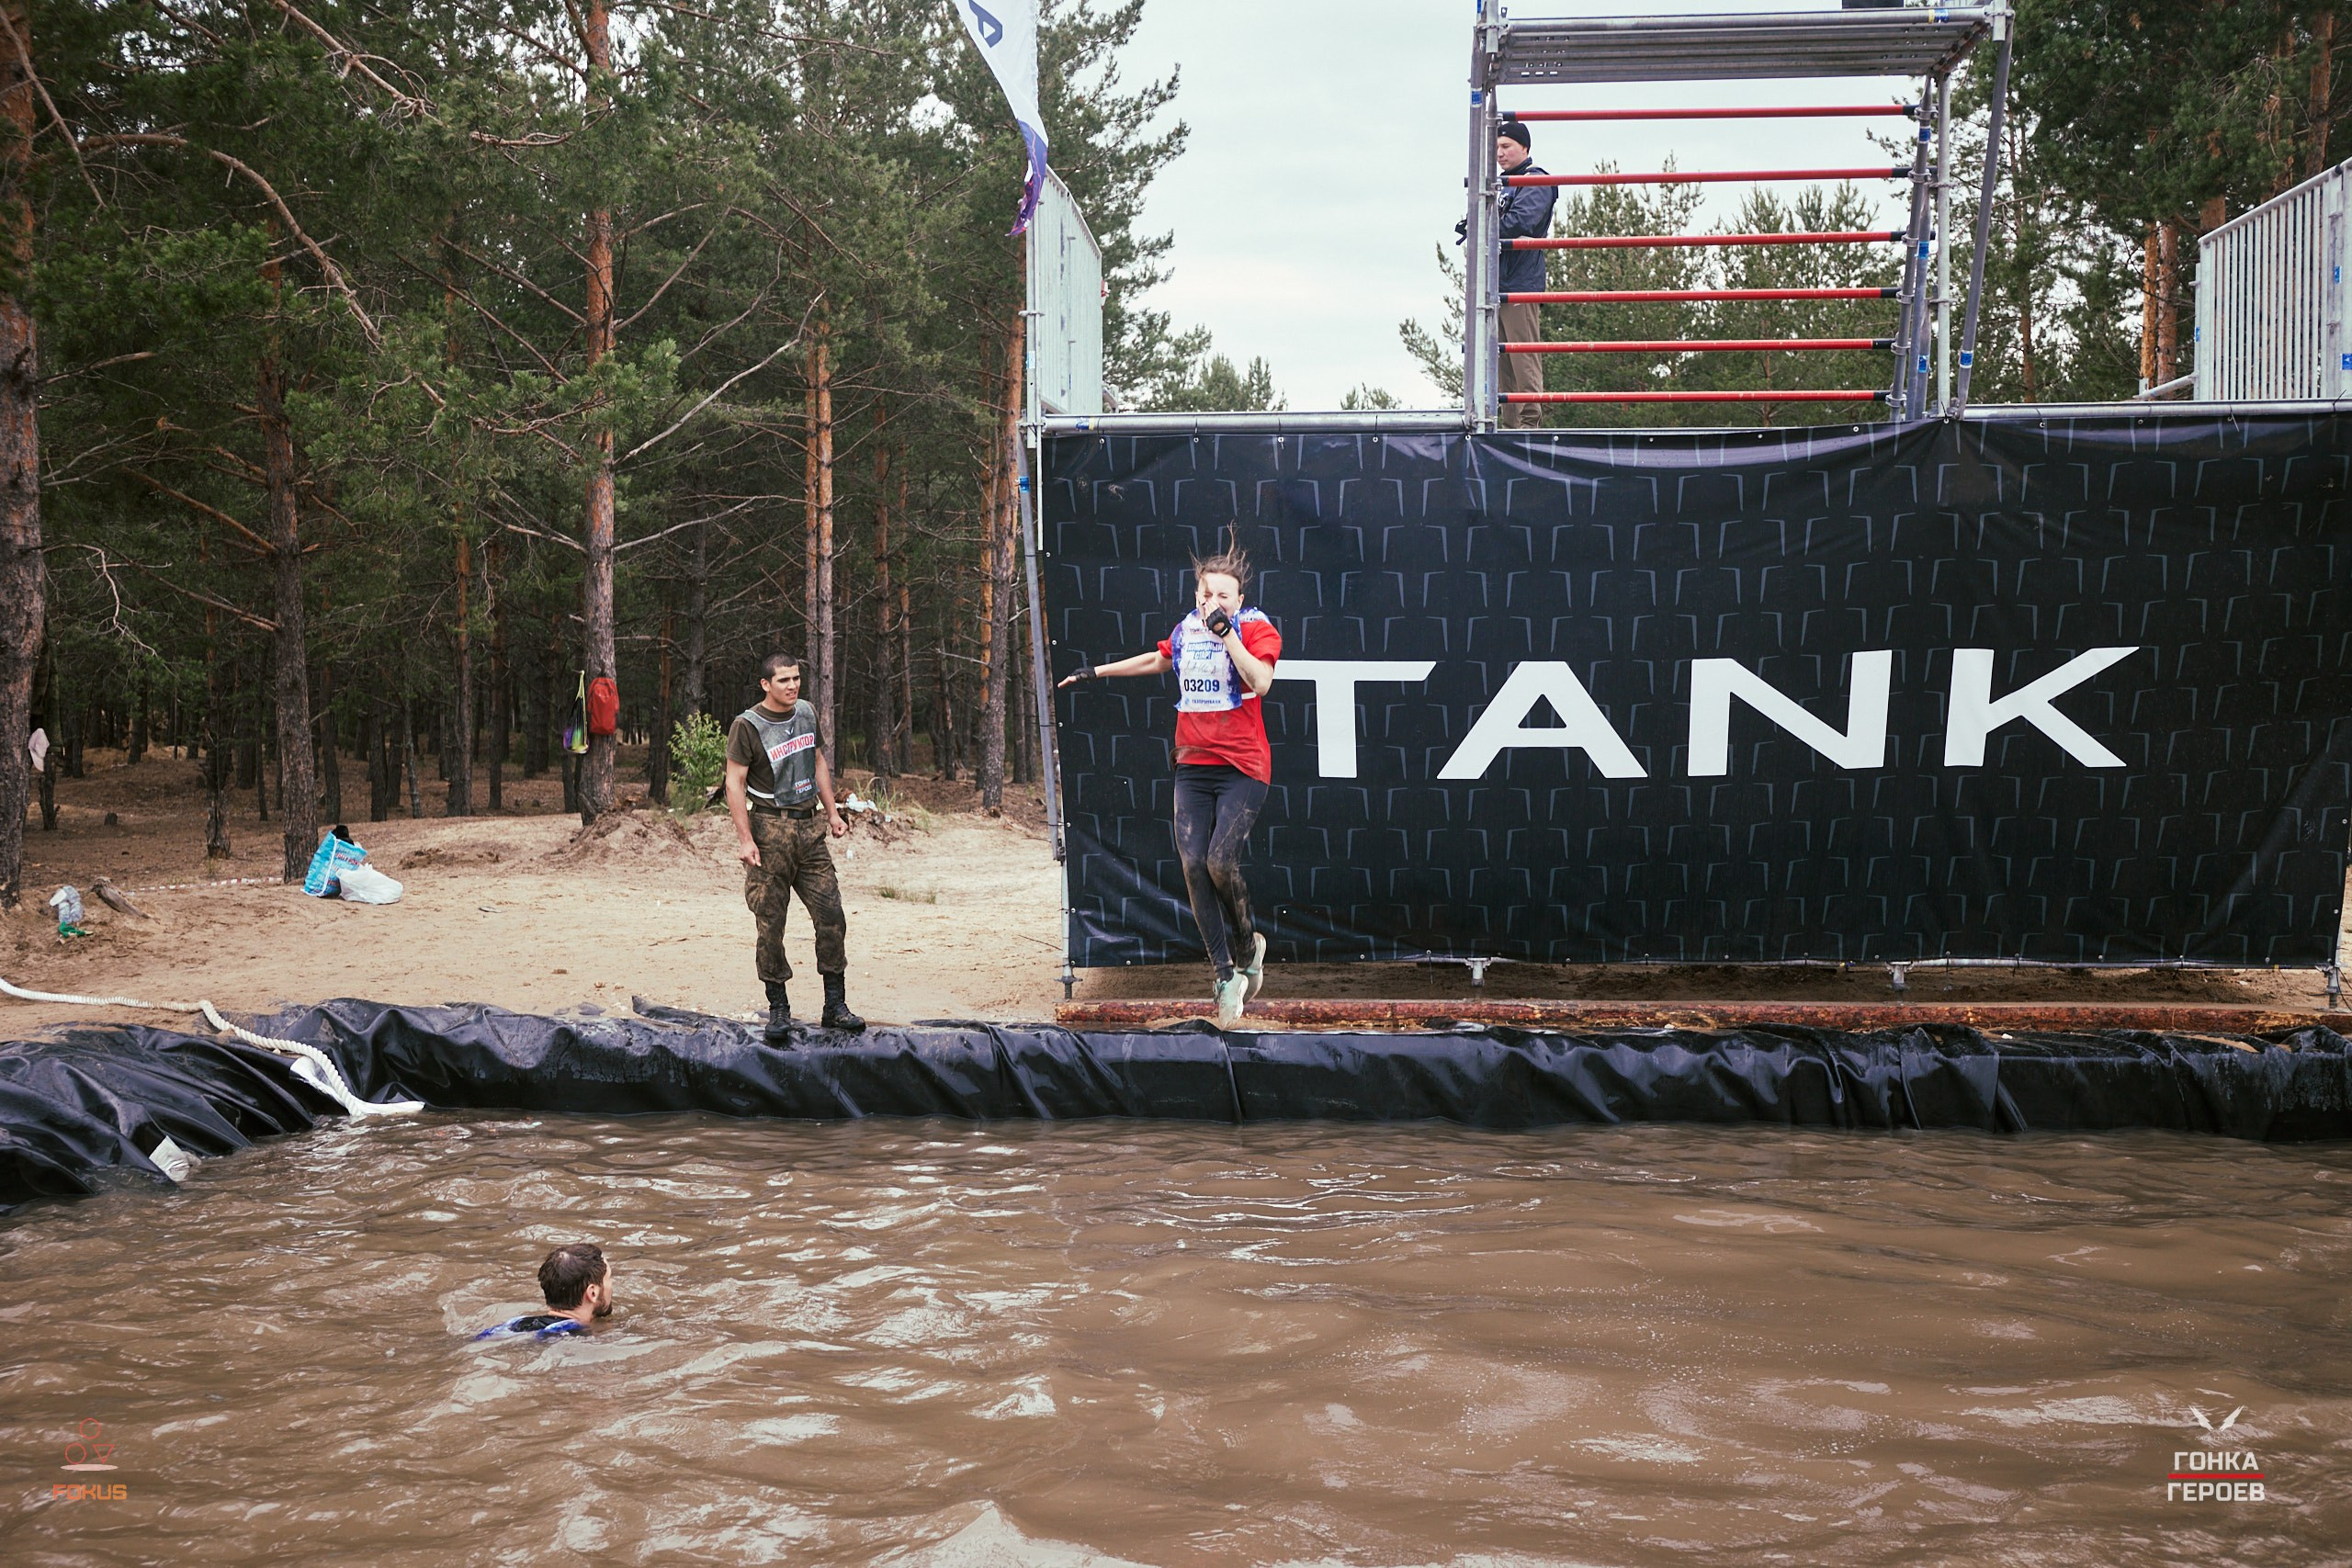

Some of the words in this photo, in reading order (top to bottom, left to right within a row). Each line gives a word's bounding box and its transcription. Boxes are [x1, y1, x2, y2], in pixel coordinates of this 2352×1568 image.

[1184, 679, 1220, 692] 03209
[1272, 646, 2140, 779] TANK
[770, 735, 814, 761] ИНСТРУКТОР
